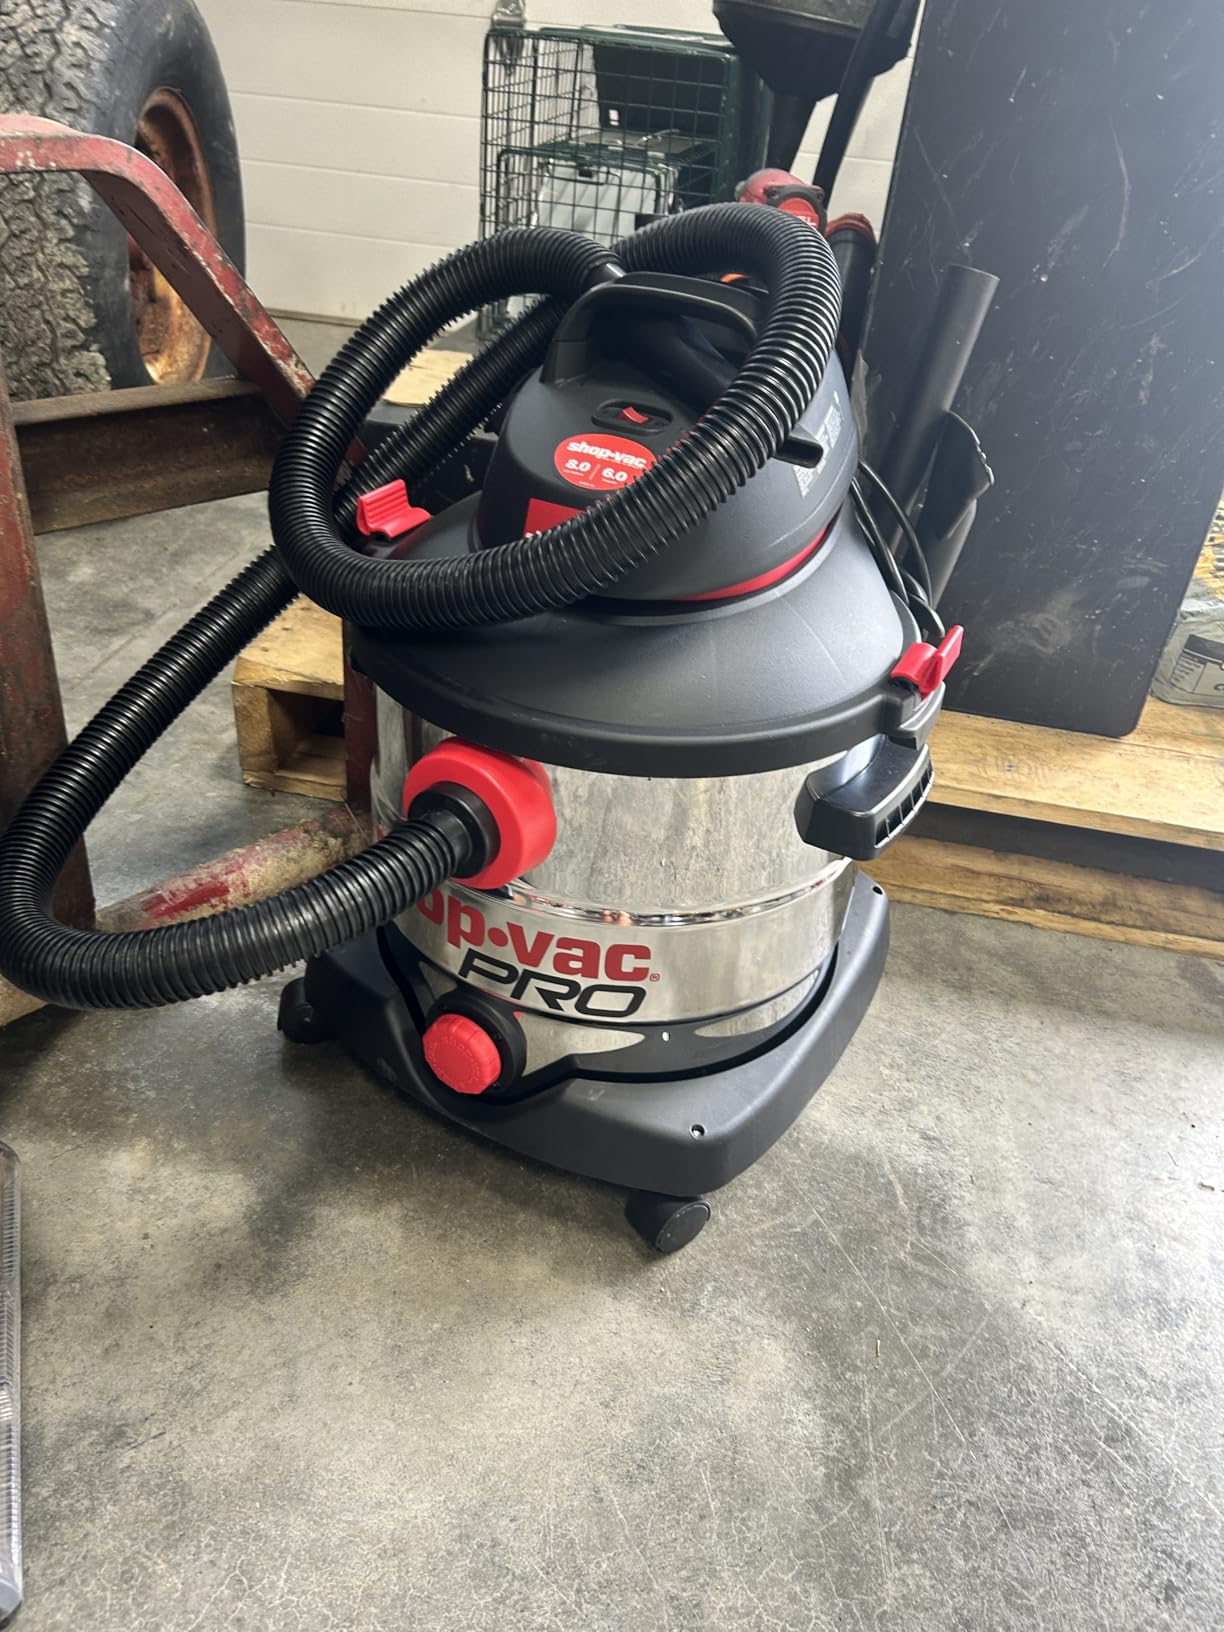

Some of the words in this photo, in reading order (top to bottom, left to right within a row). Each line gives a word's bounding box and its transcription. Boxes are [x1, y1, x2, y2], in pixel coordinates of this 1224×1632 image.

[565, 459, 592, 472] 8.0
[602, 467, 628, 481] 6.0
[458, 948, 647, 1018] PRO
